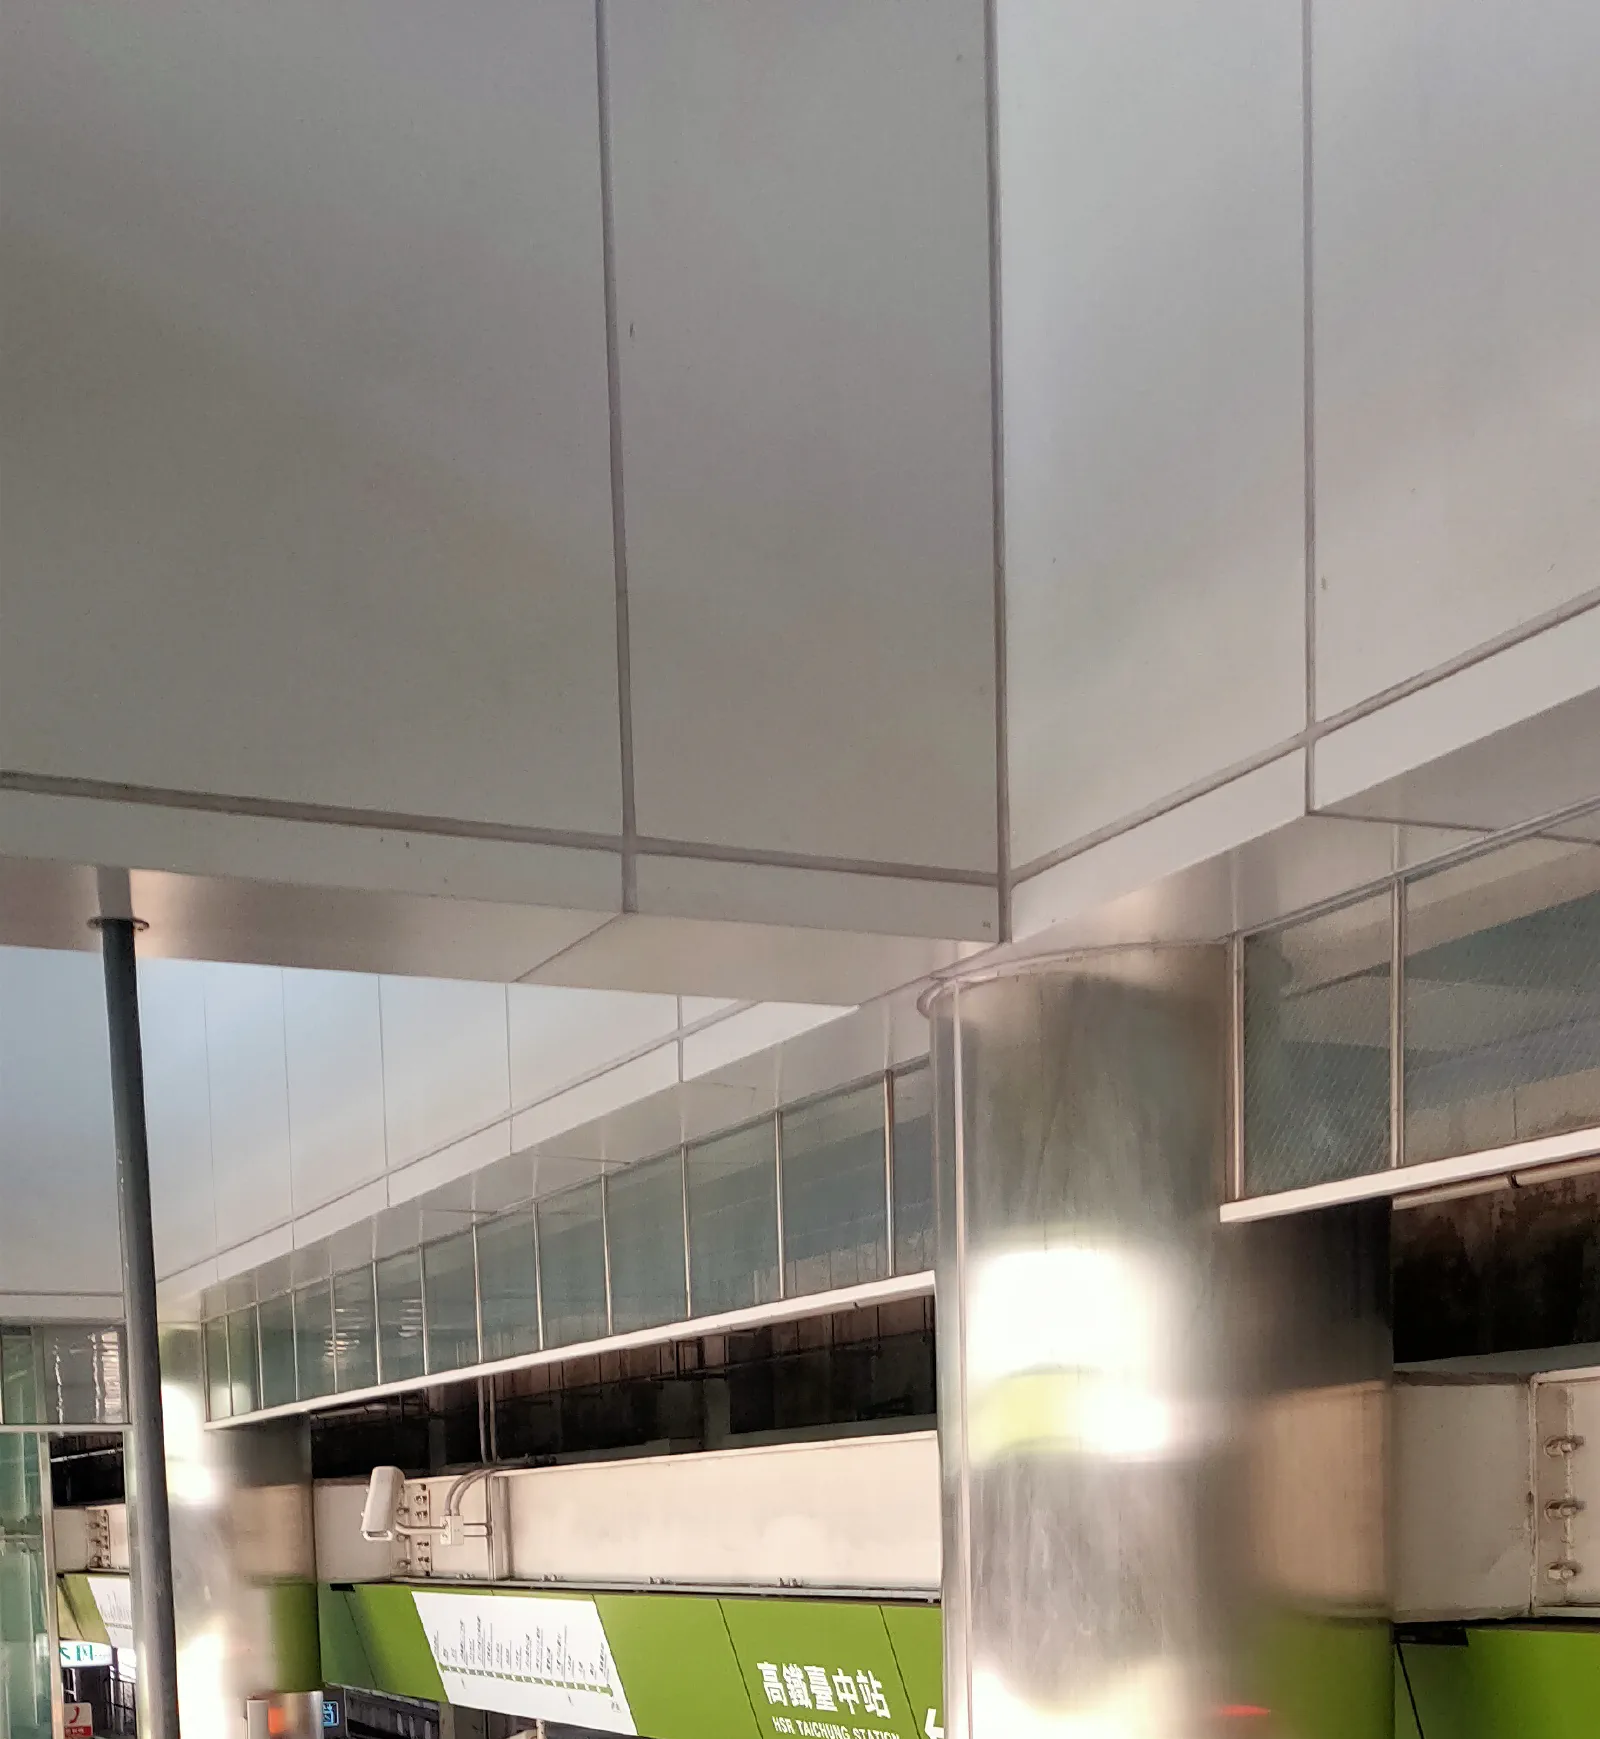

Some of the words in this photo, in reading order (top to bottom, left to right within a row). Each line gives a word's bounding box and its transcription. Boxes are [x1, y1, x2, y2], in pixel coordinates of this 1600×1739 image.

[757, 1661, 891, 1719] 高鐵臺中站
[772, 1716, 796, 1735] HSR
